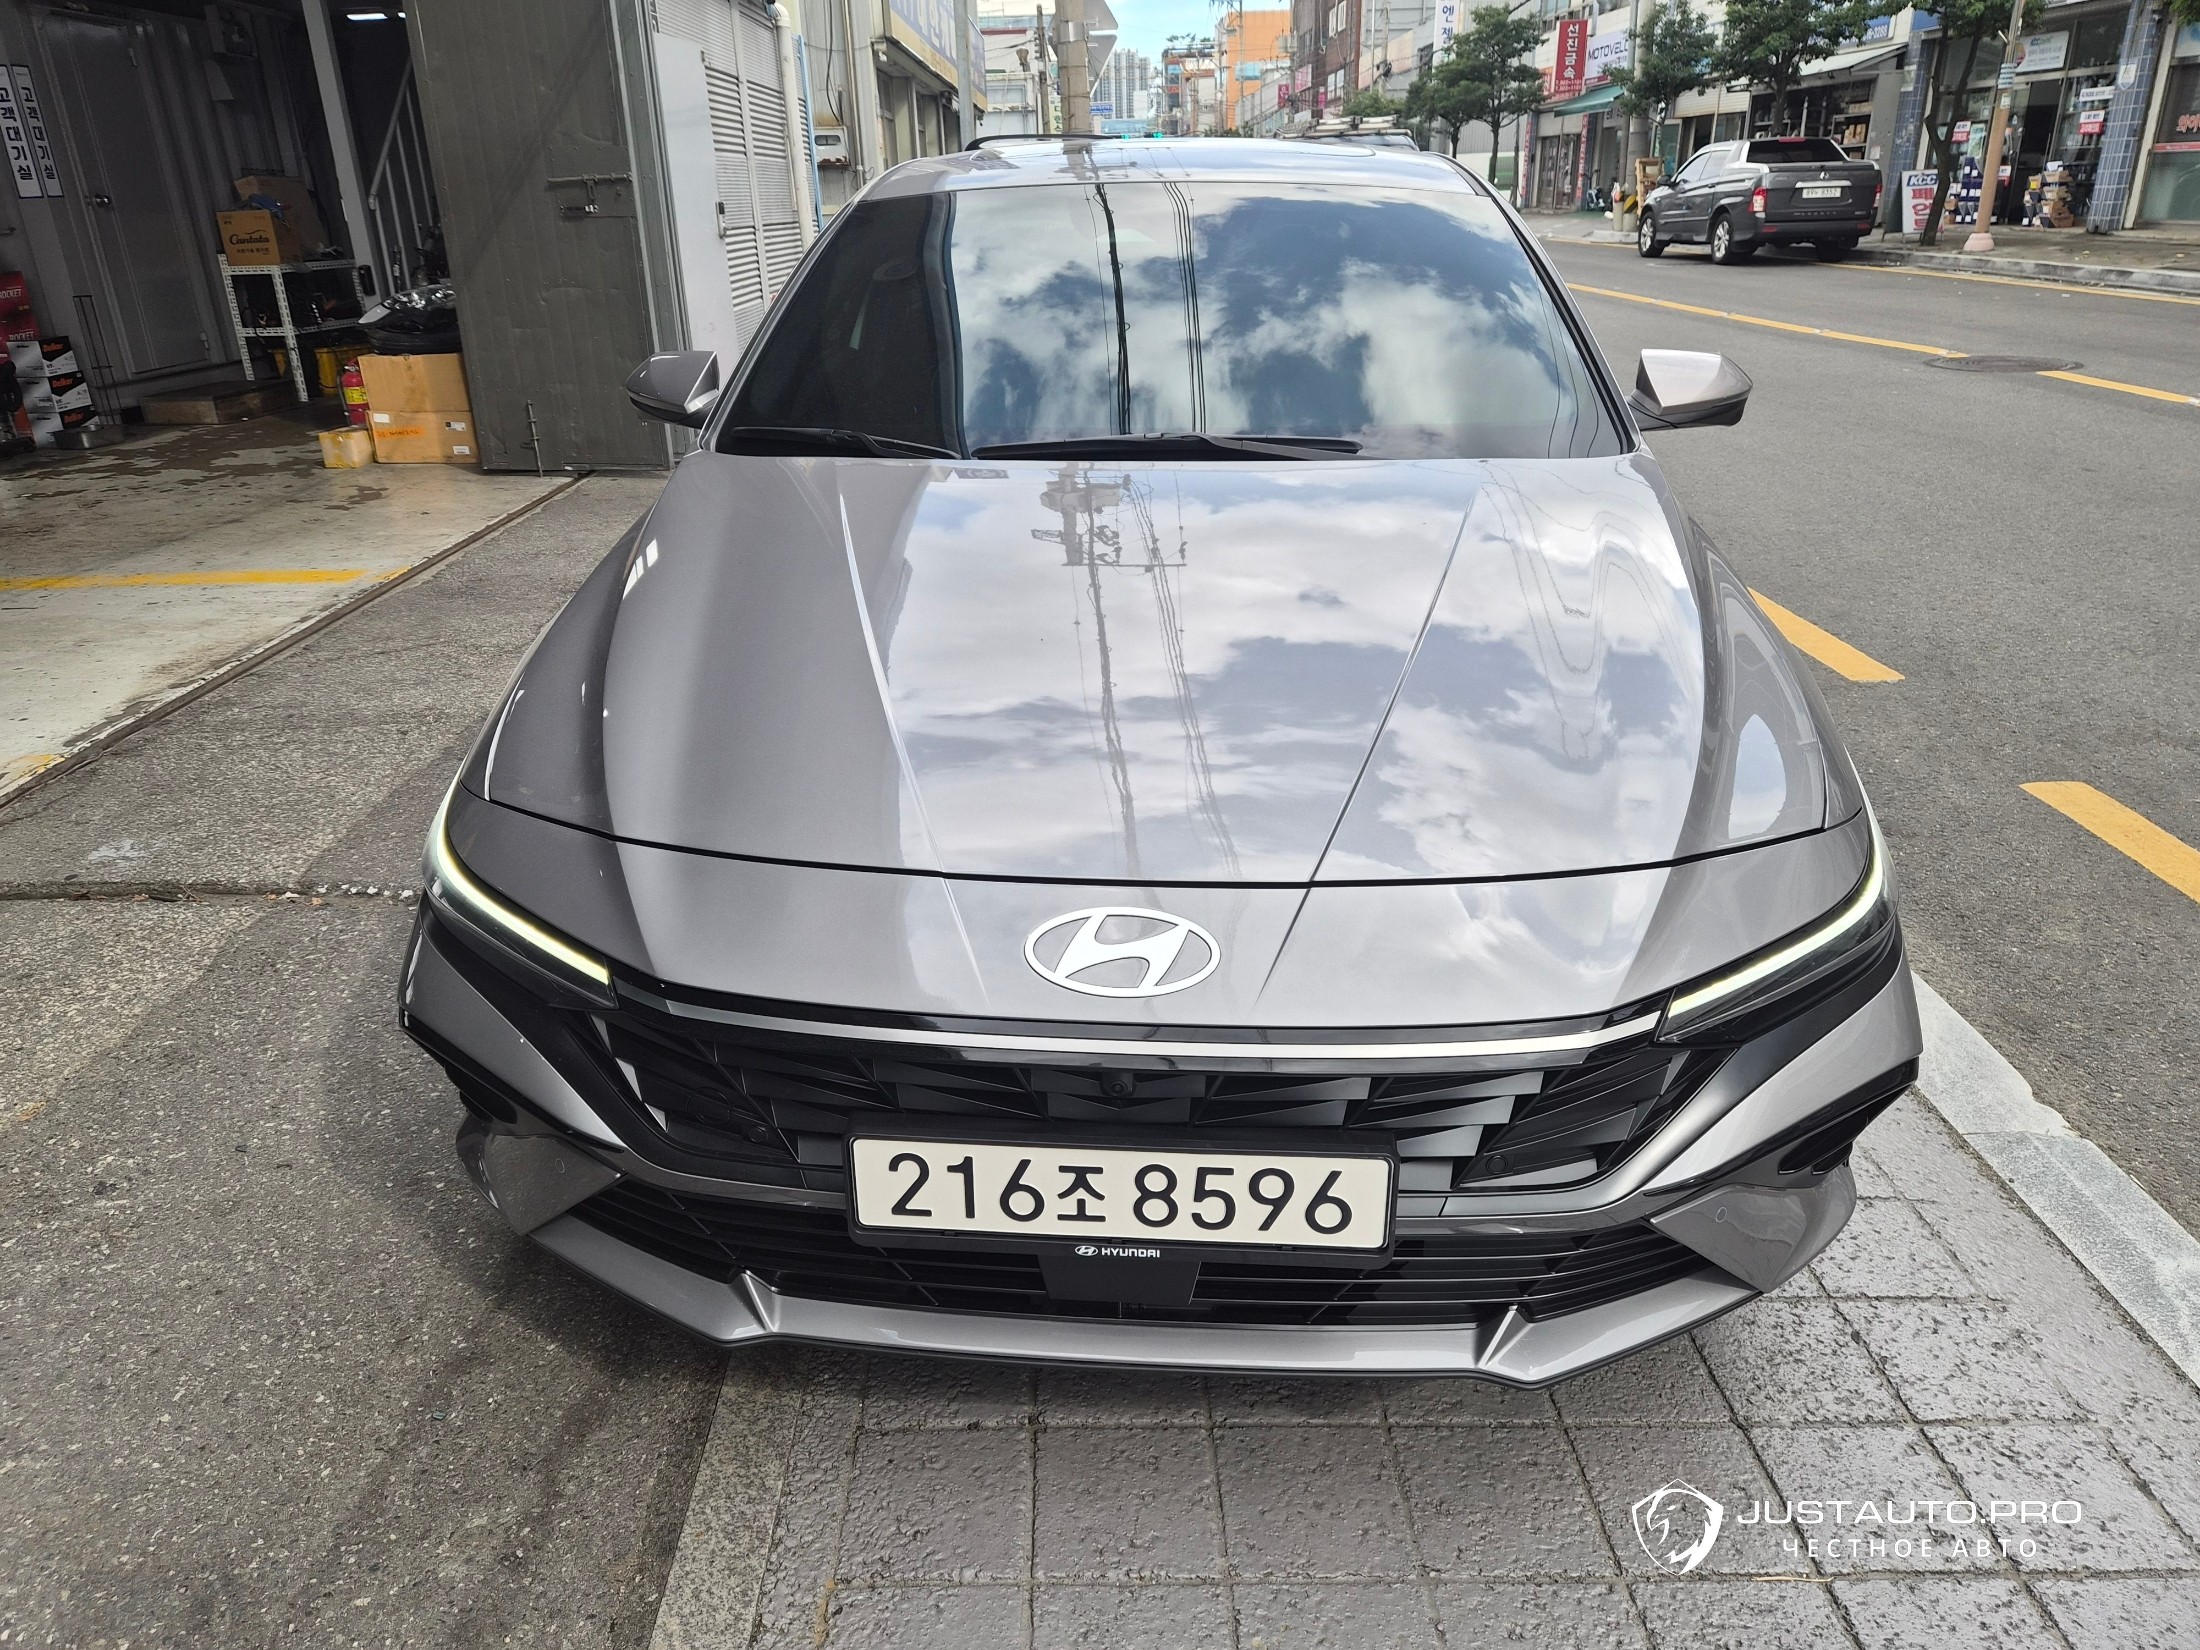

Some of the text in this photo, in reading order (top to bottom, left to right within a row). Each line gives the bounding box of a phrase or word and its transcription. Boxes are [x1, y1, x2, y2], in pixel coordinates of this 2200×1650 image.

[1563, 23, 1580, 79] 선진금속
[0, 87, 34, 180] 고객대기실
[21, 87, 56, 180] 고객대기실
[1909, 174, 1937, 186] KCC
[230, 234, 269, 245] Cantata
[889, 1153, 1352, 1235] 216조 8596
[1102, 1248, 1160, 1257] HYUNDAI
